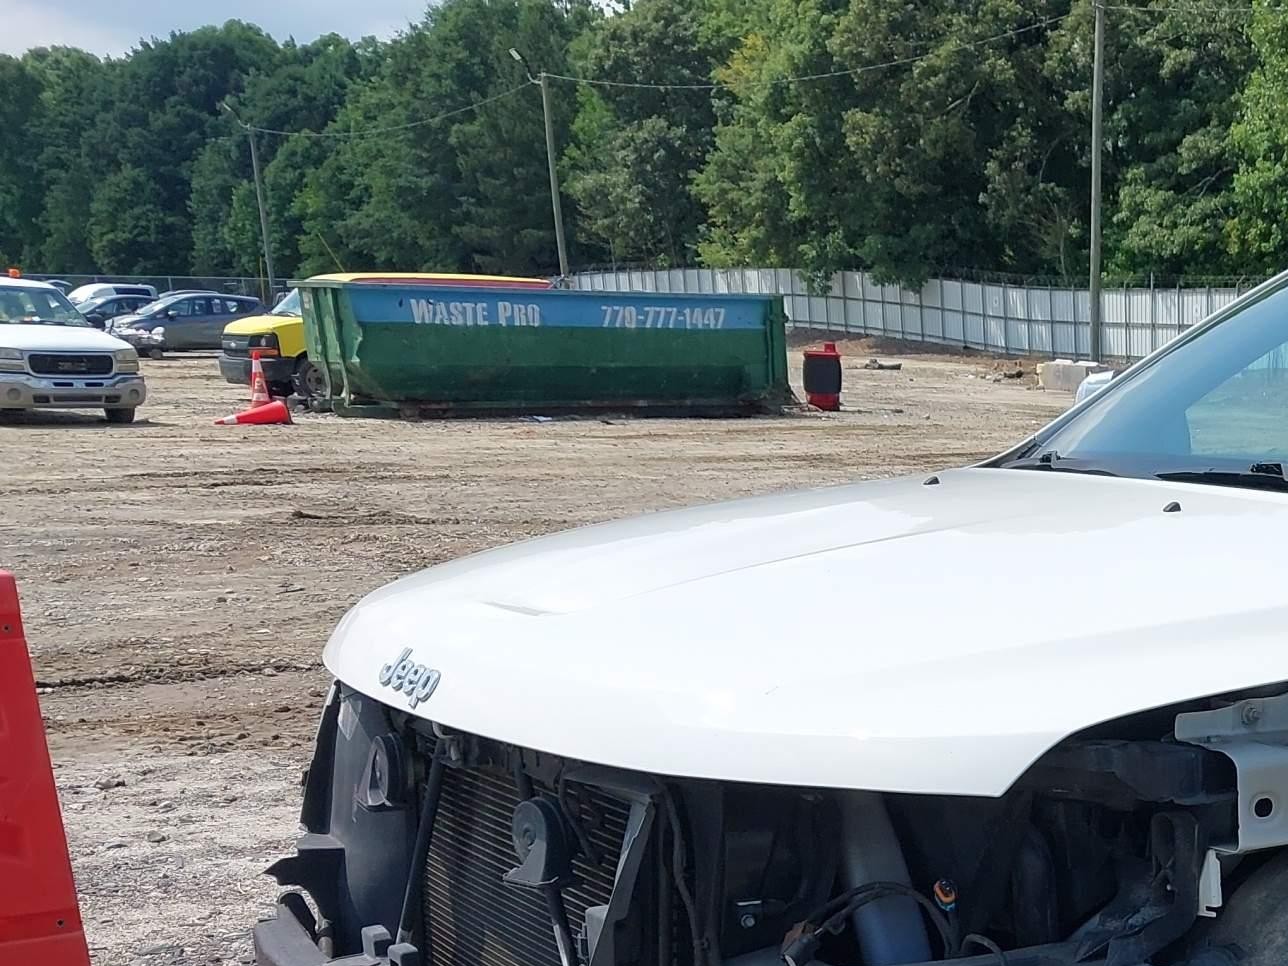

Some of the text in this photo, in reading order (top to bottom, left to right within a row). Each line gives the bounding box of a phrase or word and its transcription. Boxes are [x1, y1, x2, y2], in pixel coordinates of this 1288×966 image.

[410, 299, 541, 327] WASTE PRO
[601, 306, 726, 329] 770-777-1447
[379, 647, 441, 711] Jeep
